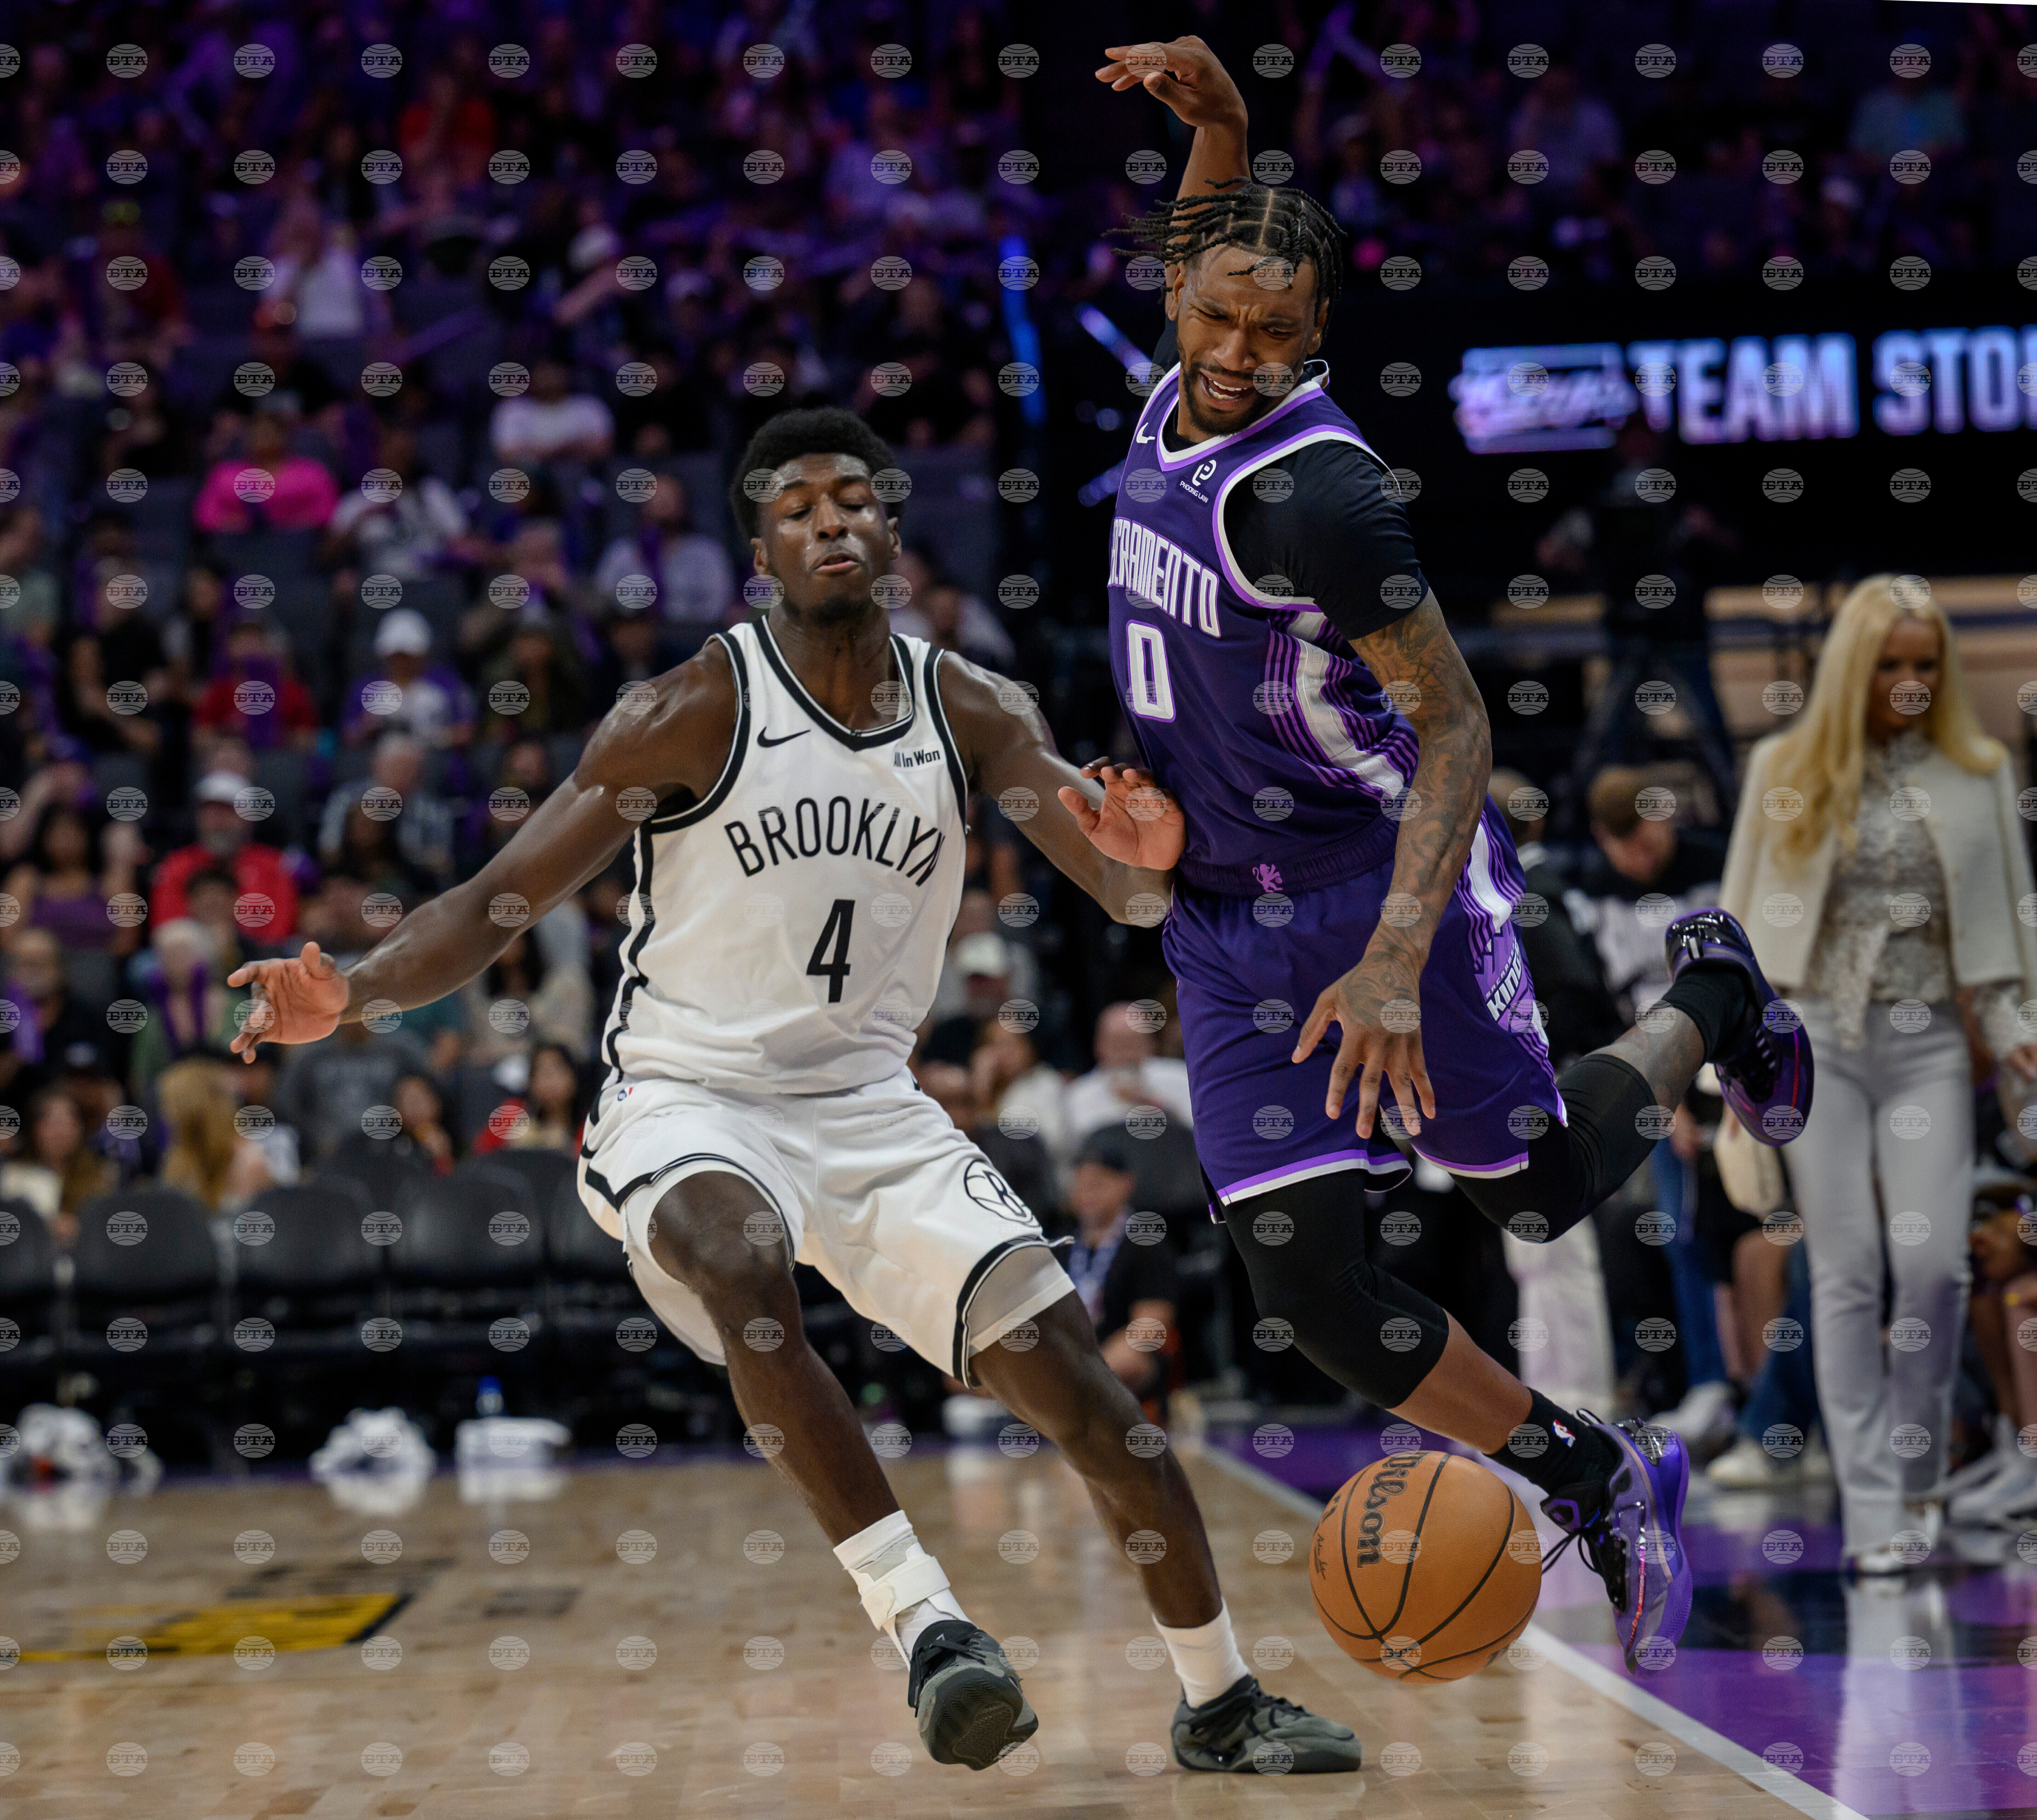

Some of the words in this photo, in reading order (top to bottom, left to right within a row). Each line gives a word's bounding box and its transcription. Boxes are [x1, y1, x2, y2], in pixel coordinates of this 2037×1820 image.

[1626, 332, 1860, 444] TEAM
[1180, 480, 1199, 497] PHOONG
[1198, 493, 1209, 503] LAW
[1107, 517, 1221, 638] ACRAMENTO
[902, 752, 914, 768] In
[913, 749, 940, 766] Won
[724, 796, 945, 887] BROOKLYN
[806, 899, 856, 1003] 4
